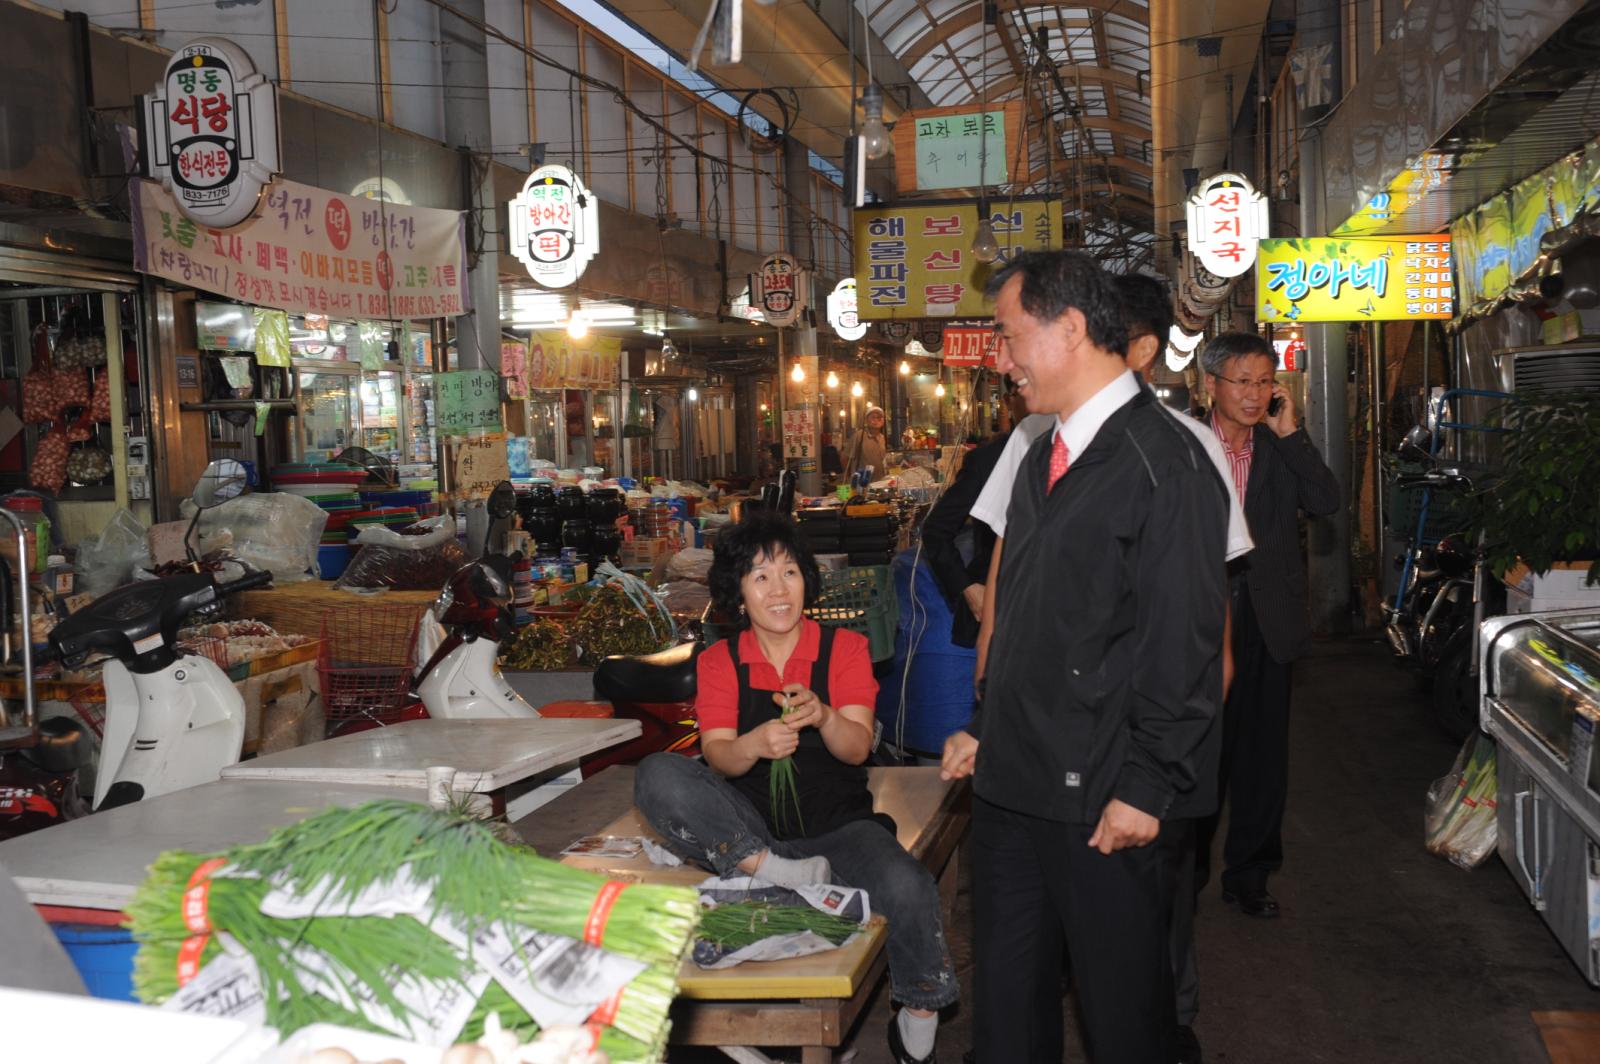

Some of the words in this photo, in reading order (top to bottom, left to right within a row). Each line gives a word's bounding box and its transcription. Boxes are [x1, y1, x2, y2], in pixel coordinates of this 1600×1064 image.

[177, 70, 222, 94] 명동
[171, 93, 232, 134] 식당
[178, 150, 229, 179] 한식전문
[185, 187, 228, 198] 833-7176
[533, 187, 564, 201] 역전
[268, 190, 315, 236] 역전
[327, 206, 348, 242] 떡
[1209, 191, 1246, 263] 선지국
[540, 234, 560, 258] 떡
[868, 216, 909, 306] 해물파전
[923, 216, 964, 304] 보신탕
[1266, 257, 1387, 301] 정아네
